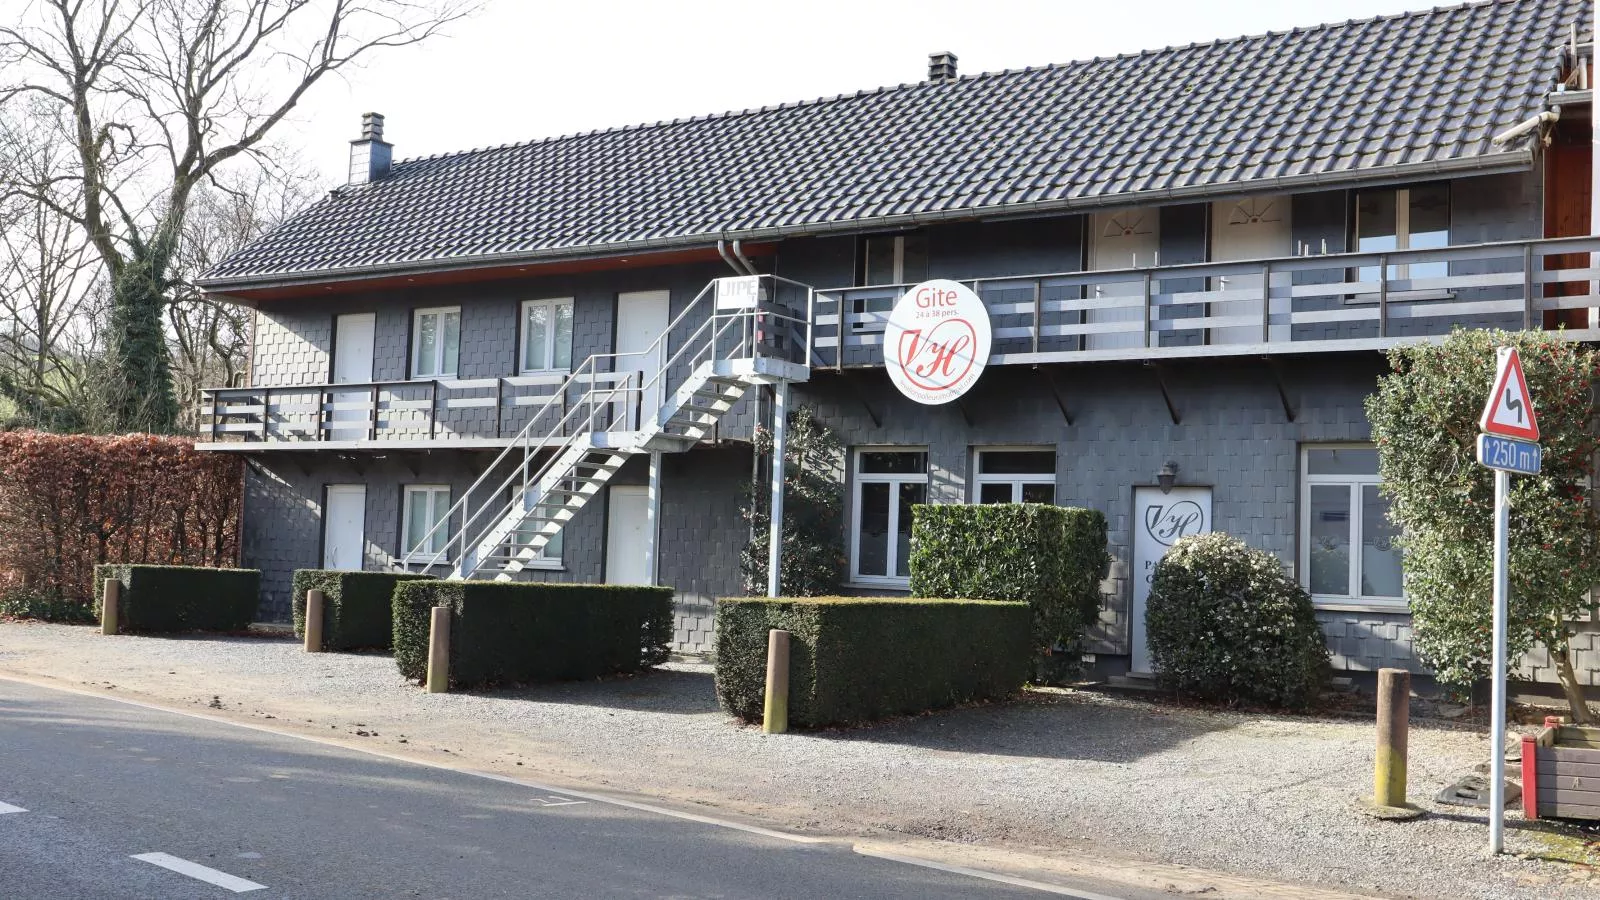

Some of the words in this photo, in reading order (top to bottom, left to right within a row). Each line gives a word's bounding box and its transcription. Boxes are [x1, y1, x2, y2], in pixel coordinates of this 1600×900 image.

[916, 288, 957, 308] Gite
[1492, 440, 1517, 467] 250
[1520, 450, 1530, 470] m
